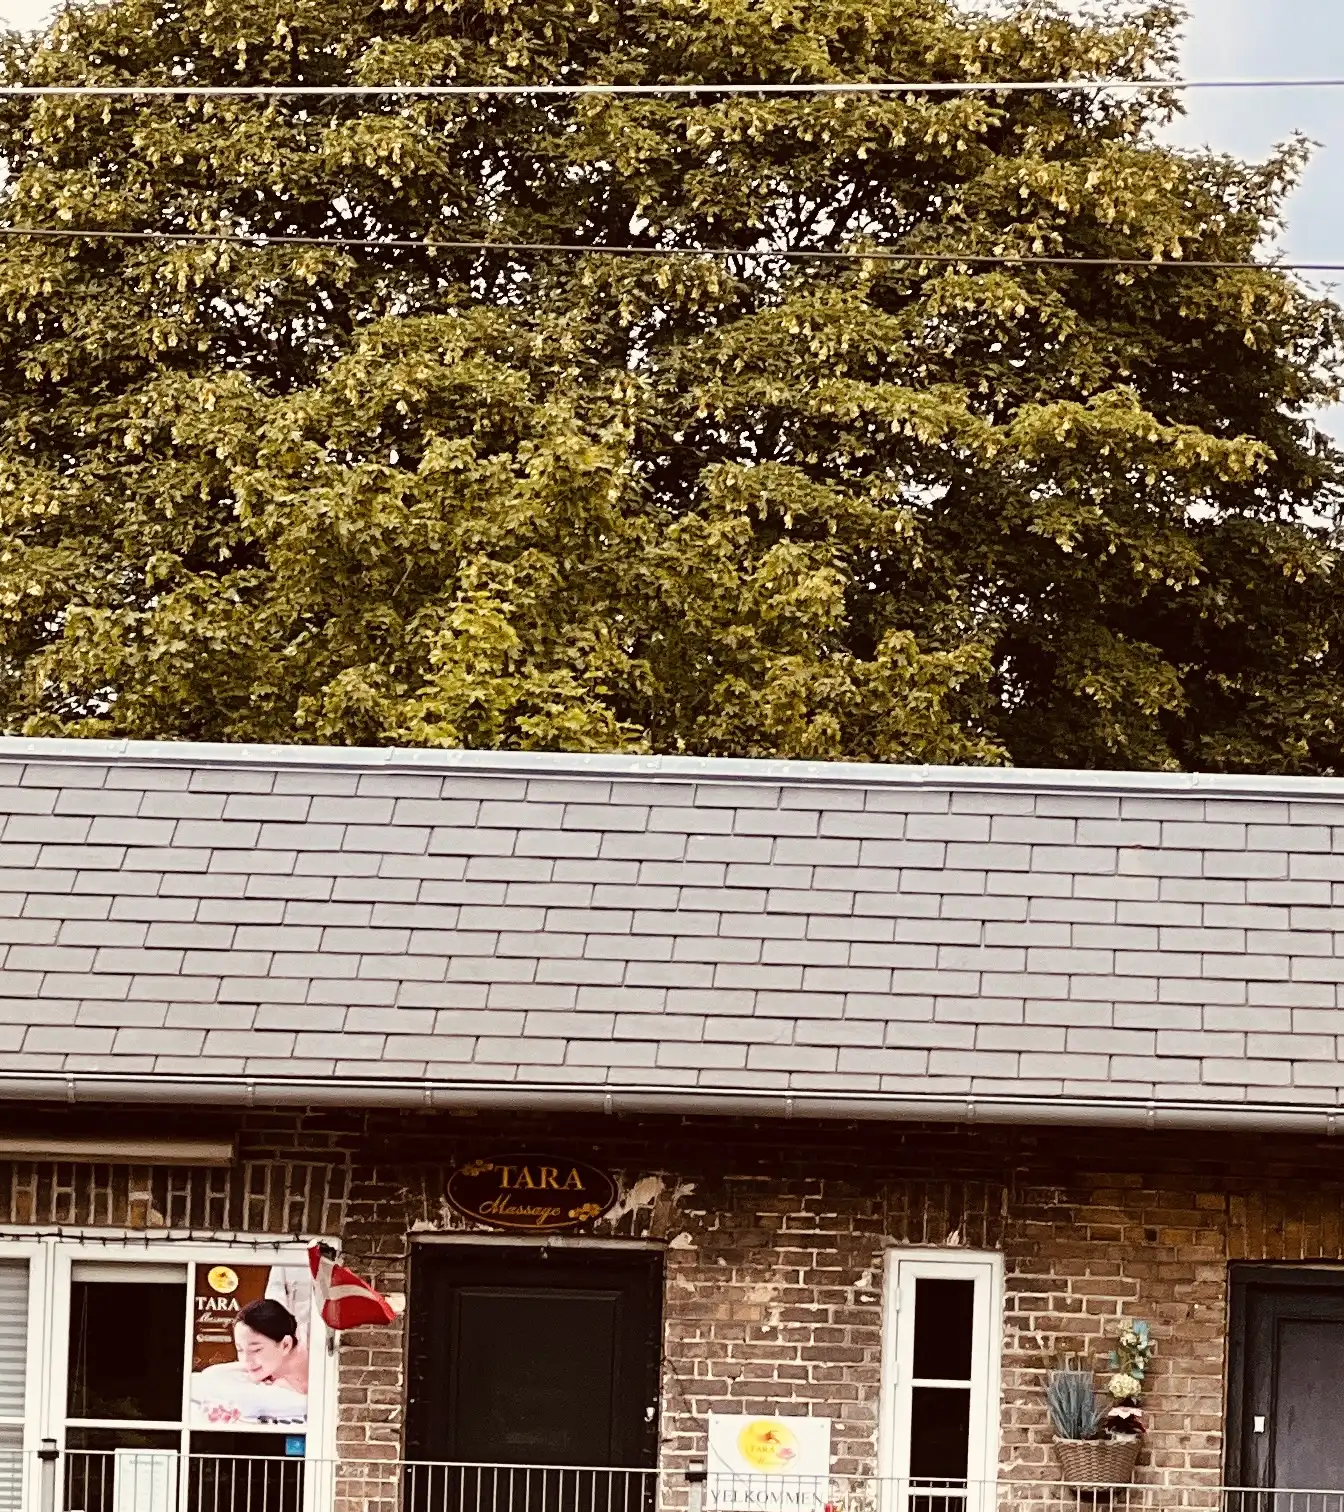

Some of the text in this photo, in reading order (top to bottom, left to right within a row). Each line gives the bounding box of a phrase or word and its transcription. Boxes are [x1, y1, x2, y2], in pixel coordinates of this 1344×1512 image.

[495, 1165, 586, 1191] TARA
[479, 1194, 561, 1225] Massage
[196, 1296, 240, 1311] TARA
[710, 1488, 824, 1507] VELKOMMEN
